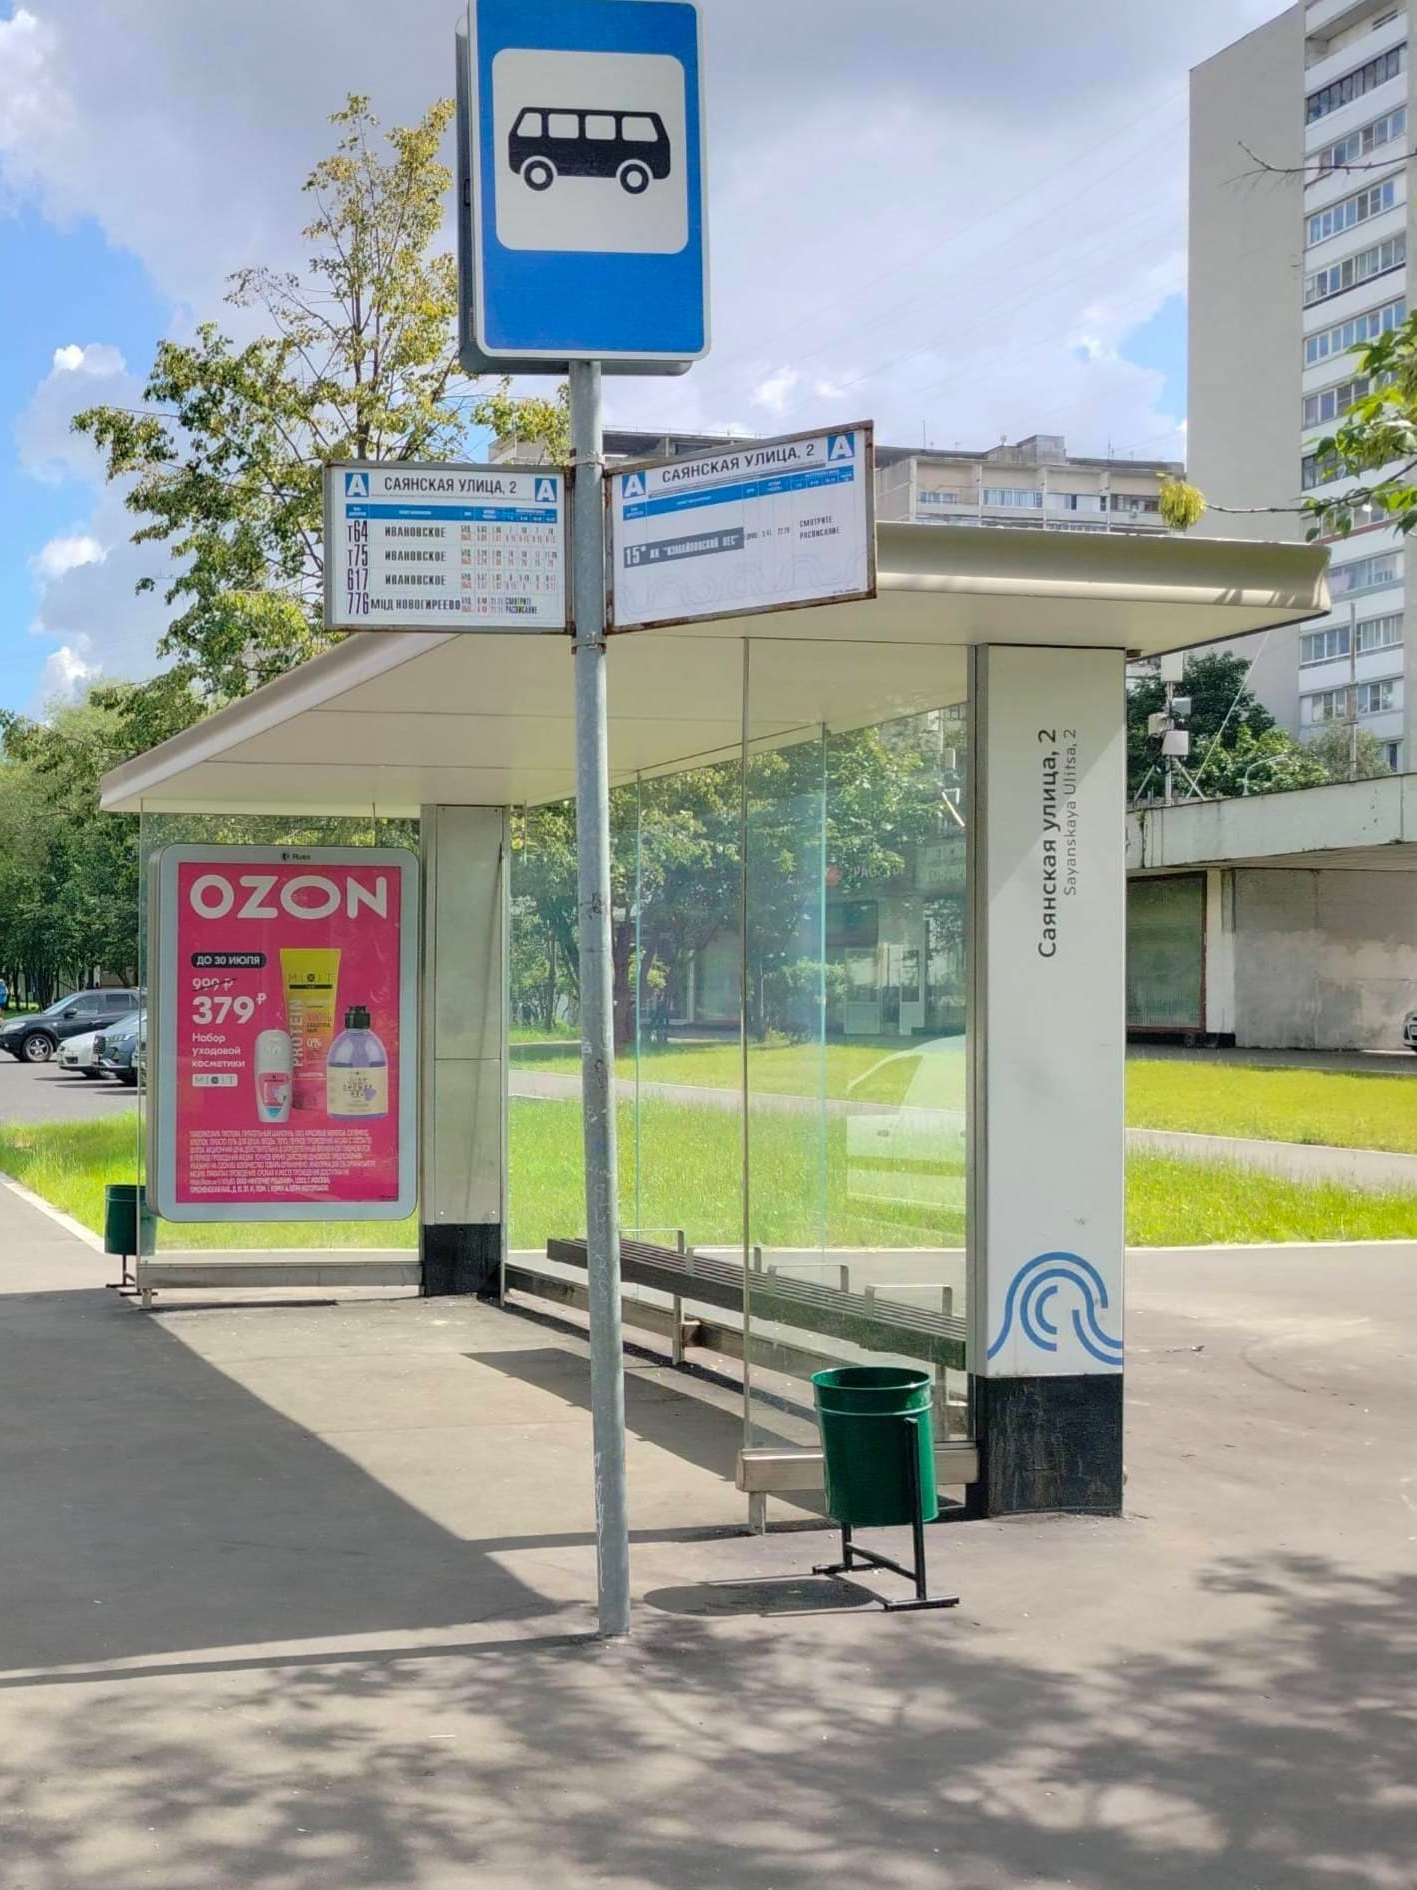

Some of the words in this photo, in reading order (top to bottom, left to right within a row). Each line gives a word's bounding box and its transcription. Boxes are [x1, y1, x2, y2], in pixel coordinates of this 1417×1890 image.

[662, 457, 740, 483] САЯНСКАЯ
[744, 446, 801, 468] УЛИЦА,
[806, 443, 815, 457] 2
[384, 476, 454, 492] САЯНСКАЯ
[459, 478, 505, 495] УЛИЦА,
[509, 480, 517, 494] 2
[384, 526, 446, 538] ИВАНОВСКОЕ
[384, 550, 446, 562] ИВАНОВСКОЕ
[347, 568, 368, 590] 617
[385, 574, 446, 586] ИВАНОВСКОЕ
[347, 592, 369, 614] 776
[396, 599, 461, 611] НОВОГИРЕЕВО
[1038, 728, 1057, 744] 2
[1064, 729, 1076, 740] 2
[1064, 743, 1078, 796] Ulitsa,
[1042, 750, 1061, 832] улица,
[1064, 801, 1080, 896] Sayanskaya
[189, 874, 388, 919] OZON
[1038, 838, 1057, 958] Саянская
[196, 955, 212, 966] ДО
[214, 955, 227, 965] 30
[192, 1032, 226, 1045] Набор
[192, 1046, 241, 1057] уходовой
[192, 1060, 246, 1068] косметики
